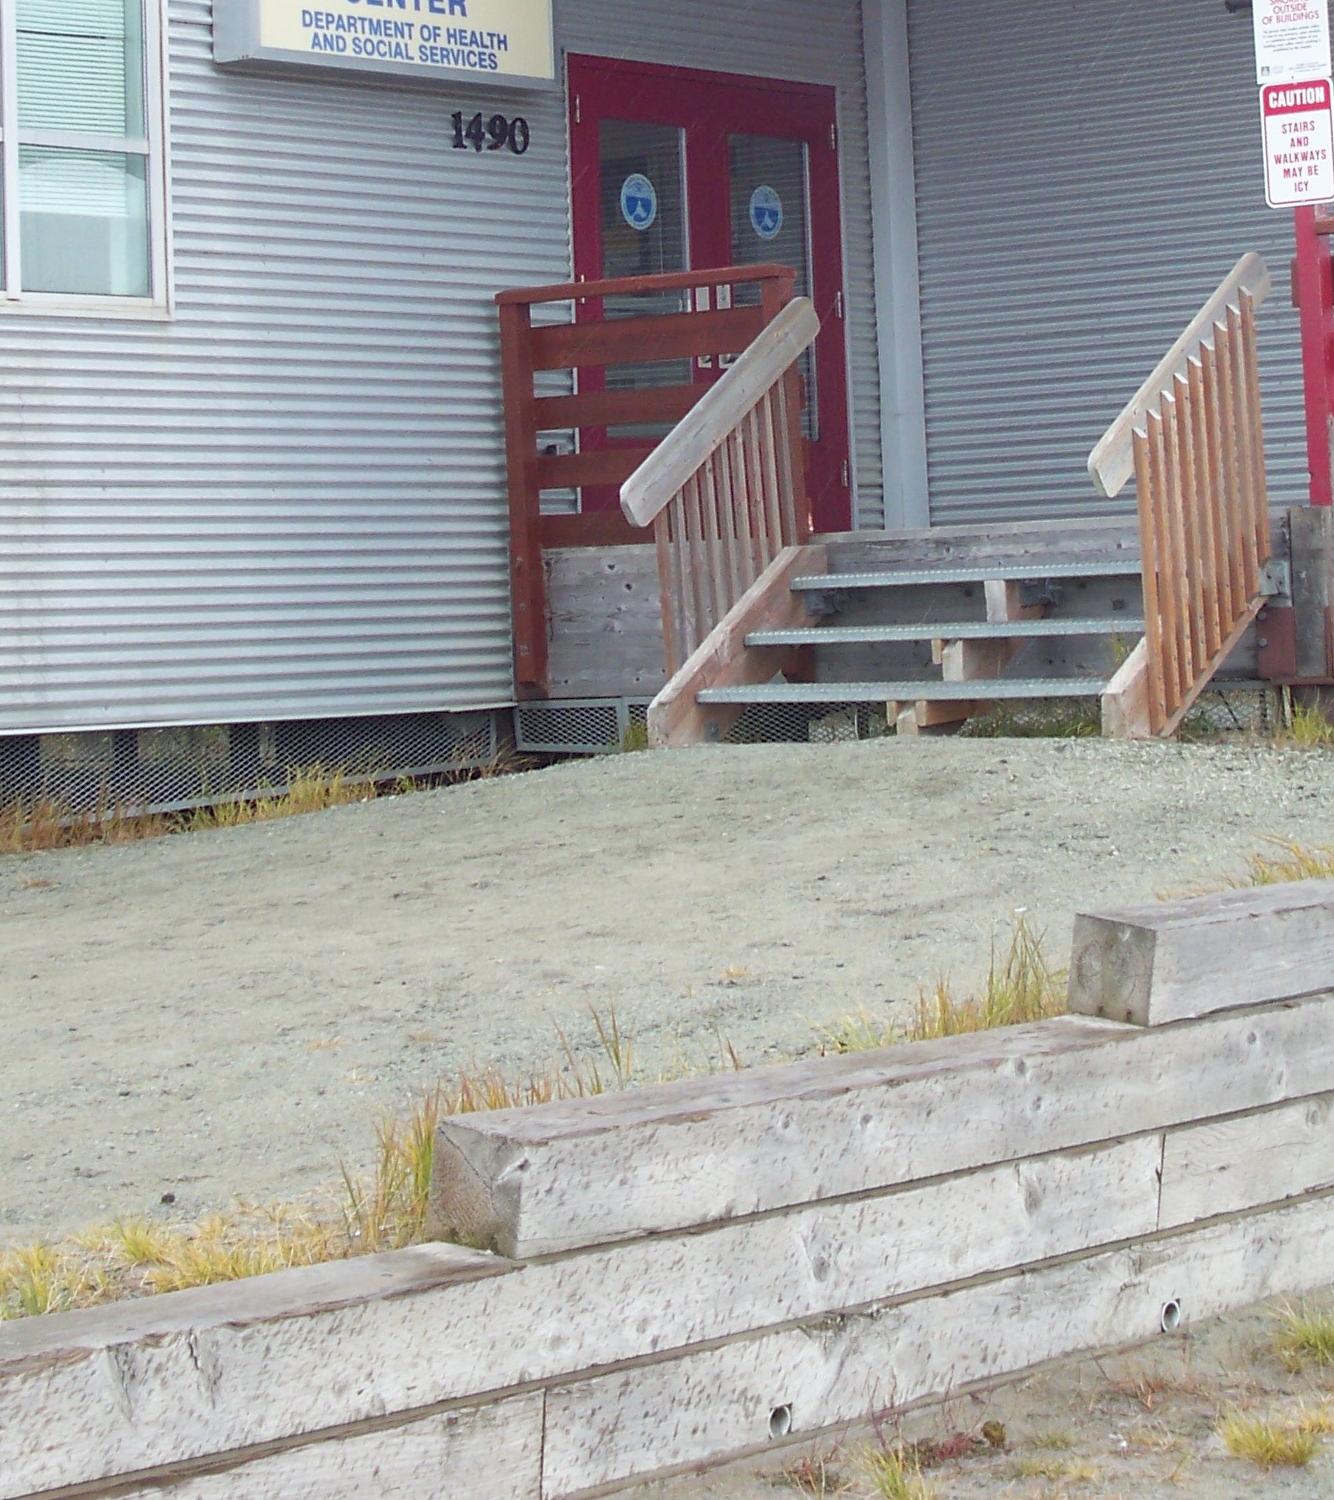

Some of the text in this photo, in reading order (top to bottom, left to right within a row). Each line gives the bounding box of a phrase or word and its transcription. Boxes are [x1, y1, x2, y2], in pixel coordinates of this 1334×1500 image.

[1272, 3, 1307, 14] OUTSIDE
[1262, 10, 1319, 25] OF BUILDINGS
[301, 9, 508, 51] DEPARTMENT OF HEALTH
[311, 32, 498, 70] AND SOCIAL SERVICES
[1268, 87, 1325, 109] CAUTION
[450, 111, 530, 155] 1490
[1281, 121, 1315, 134] STAIRS
[1290, 137, 1309, 148] AND
[1274, 149, 1327, 165] WALKWAYS
[1283, 165, 1319, 179] MAY BE
[1294, 181, 1309, 193] ICY
